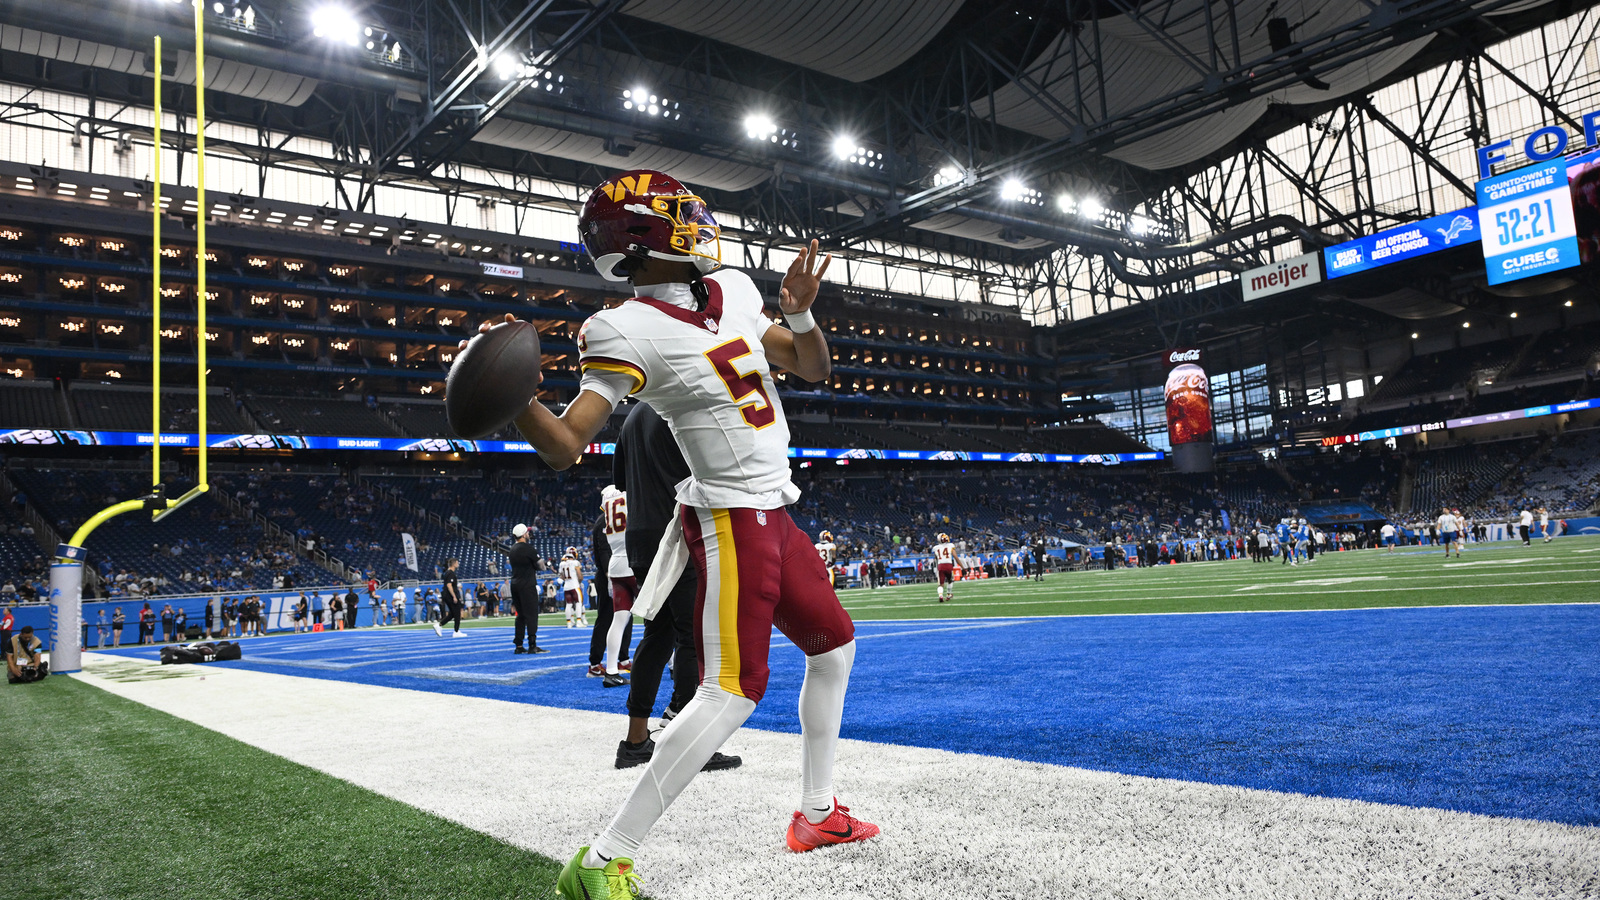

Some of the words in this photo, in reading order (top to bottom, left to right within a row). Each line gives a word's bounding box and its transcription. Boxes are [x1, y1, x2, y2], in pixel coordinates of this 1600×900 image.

[1484, 169, 1543, 194] COUNTDOWN
[1544, 167, 1557, 176] TO
[1490, 176, 1554, 200] GAMETIME
[1496, 198, 1556, 246] 52:21
[1371, 248, 1392, 261] BEER
[1392, 237, 1430, 256] SPONSOR
[1375, 238, 1388, 250] AN
[1388, 229, 1423, 247] OFFICIAL
[1333, 254, 1363, 270] LIGHT
[1336, 249, 1358, 260] BUD
[1502, 249, 1543, 270] CURE
[1251, 263, 1309, 292] meijer
[1503, 268, 1521, 276] AUTO
[1522, 258, 1560, 272] INSURANCE
[1170, 349, 1200, 362] Coca-Cola
[702, 336, 776, 431] 5
[605, 498, 627, 535] 16
[937, 547, 949, 560] 14
[562, 567, 572, 579] 11
